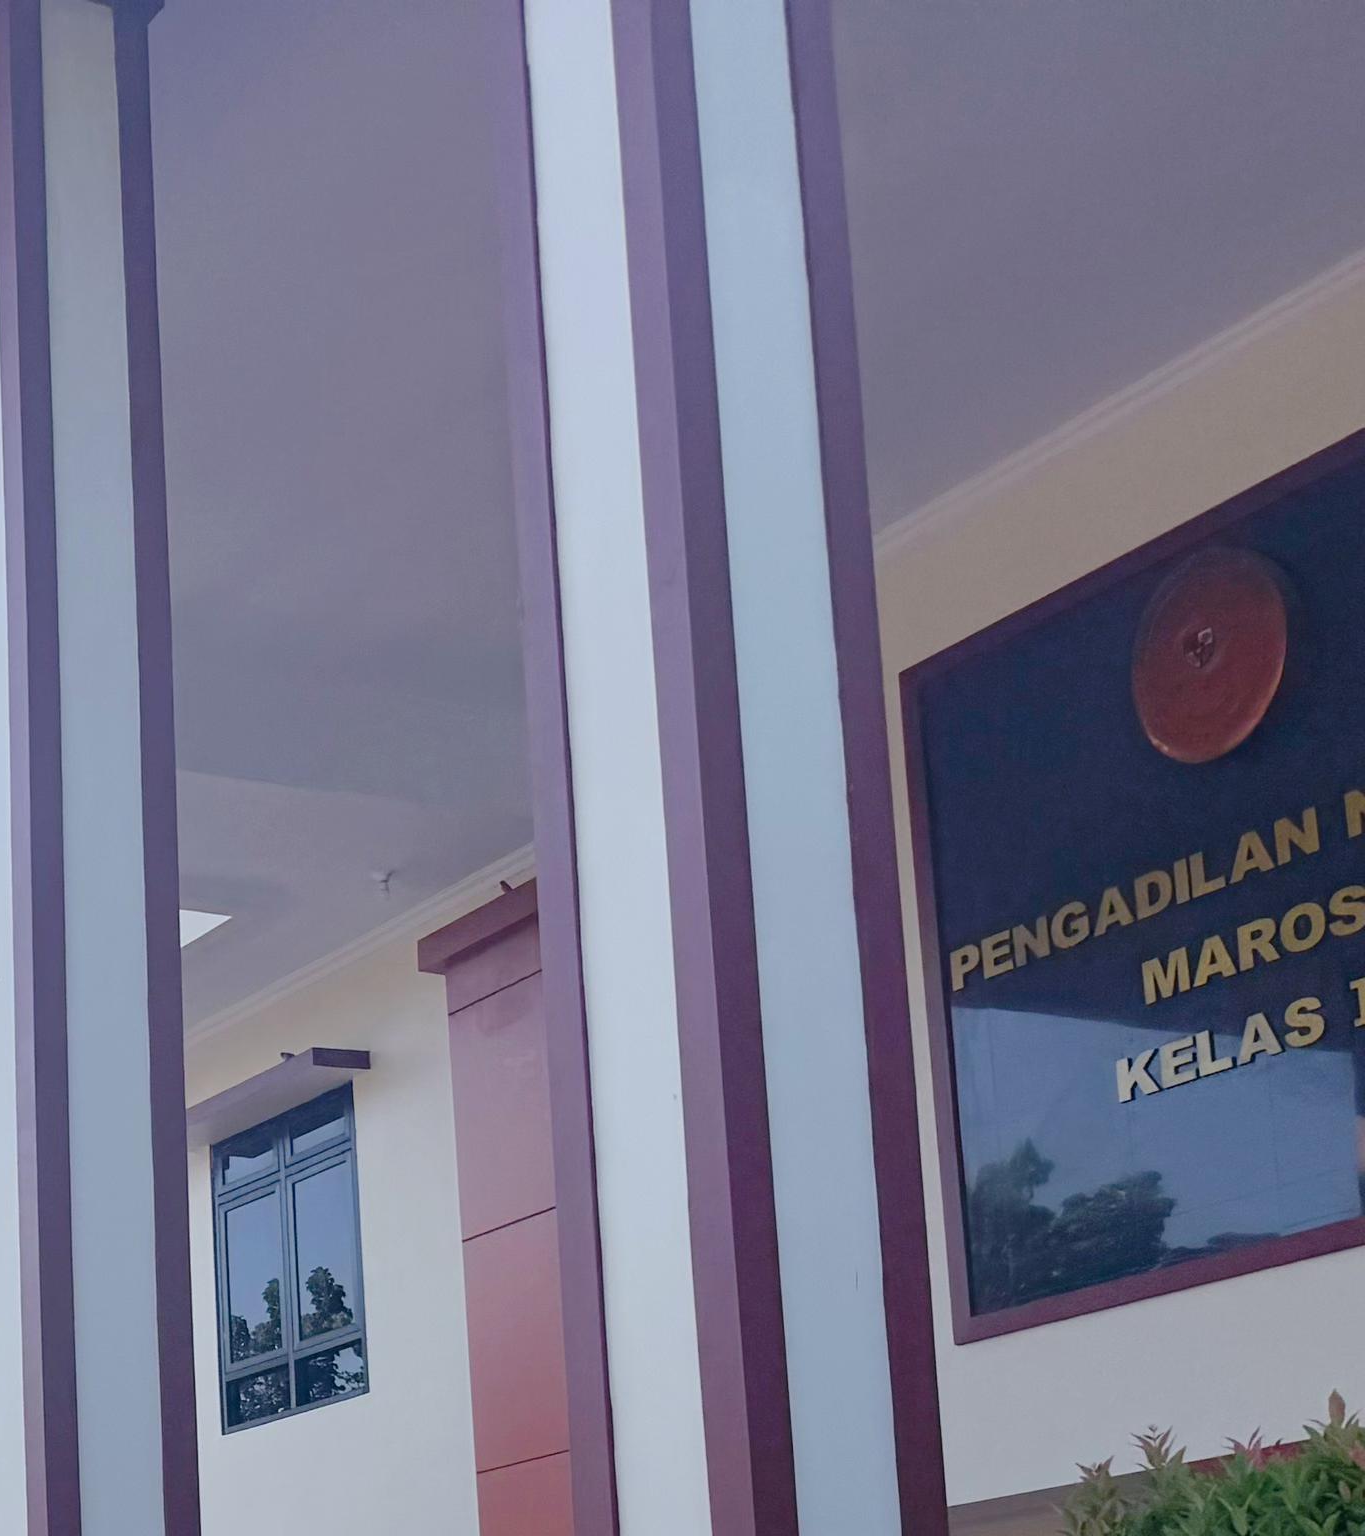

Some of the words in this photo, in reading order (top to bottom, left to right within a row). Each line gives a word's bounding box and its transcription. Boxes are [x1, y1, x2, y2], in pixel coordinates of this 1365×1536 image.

[949, 807, 1320, 993] PENGADILAN
[1141, 884, 1365, 1006] MAROS
[1116, 996, 1326, 1103] KELAS
